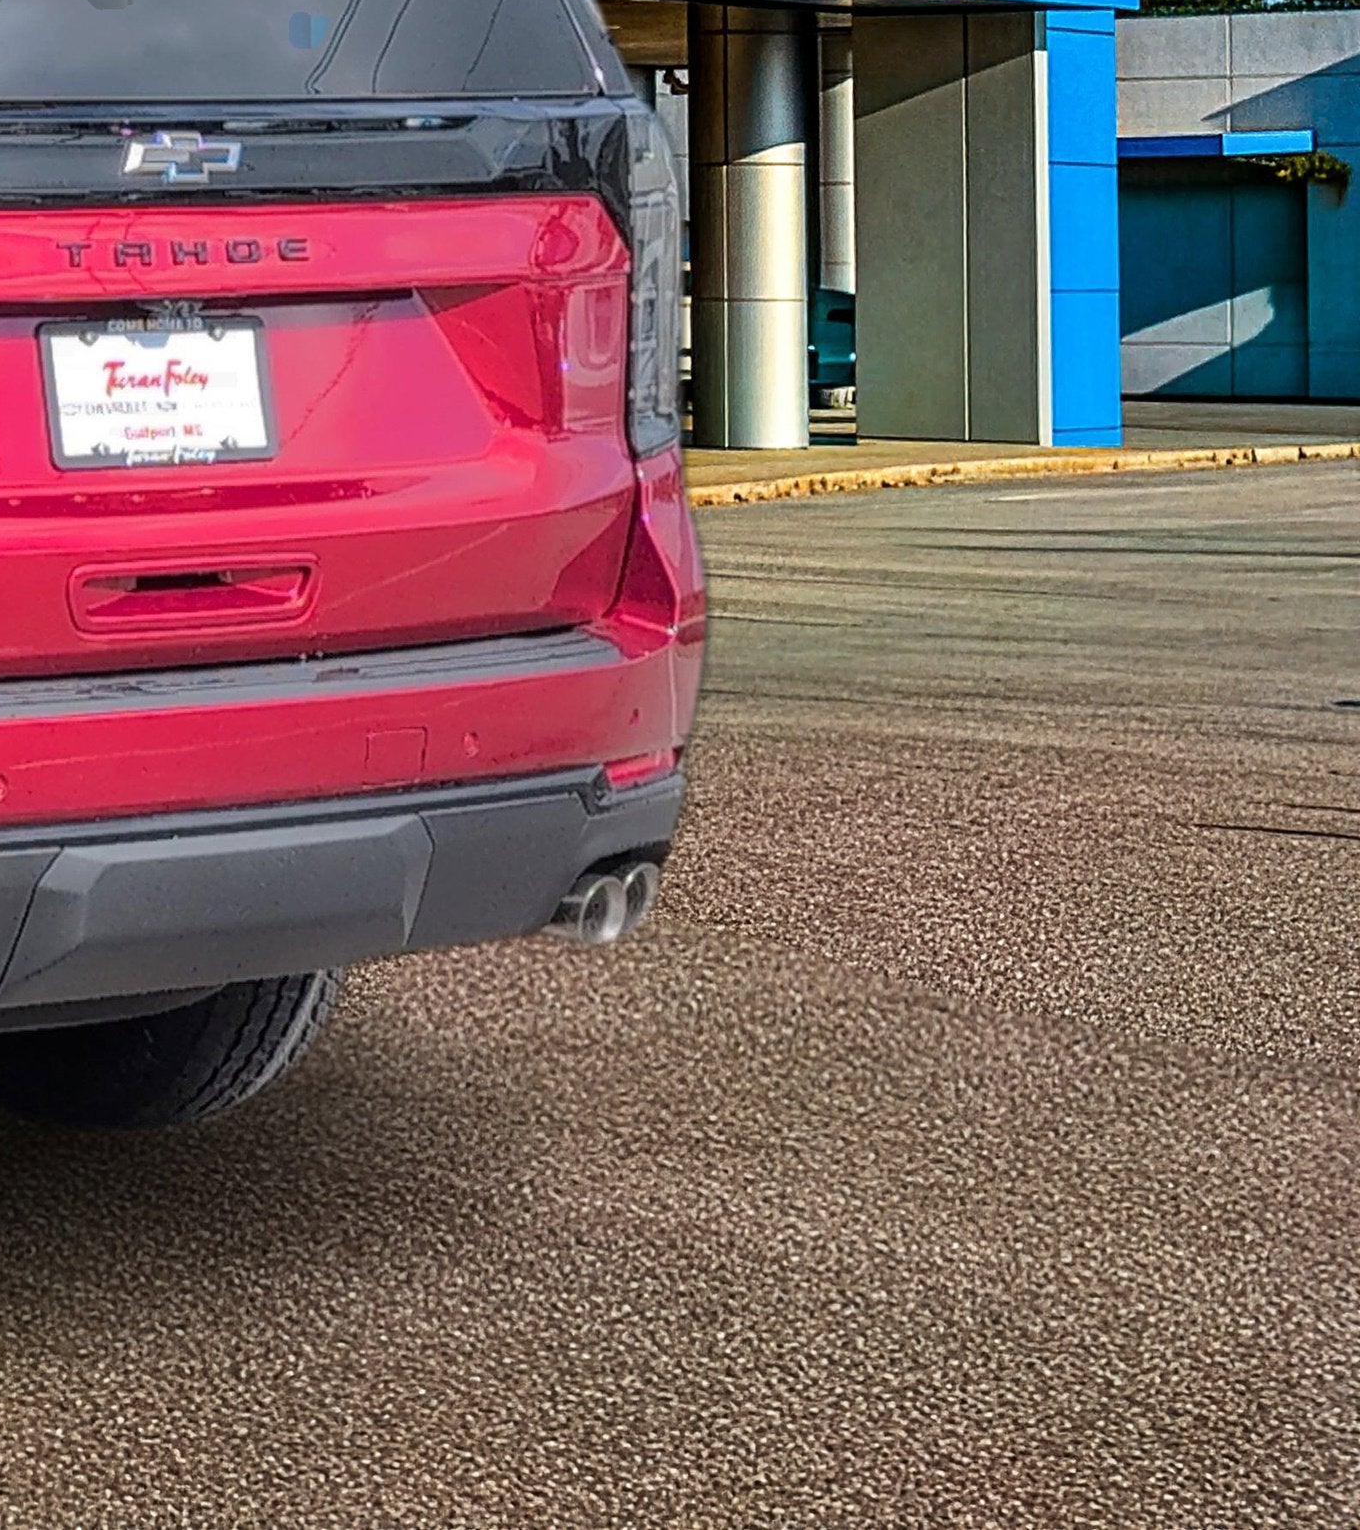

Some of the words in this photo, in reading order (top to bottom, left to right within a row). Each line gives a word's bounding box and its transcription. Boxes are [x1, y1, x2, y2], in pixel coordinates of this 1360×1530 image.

[56, 237, 311, 268] TAHOE
[102, 359, 162, 397] Turan
[163, 358, 210, 396] Foley
